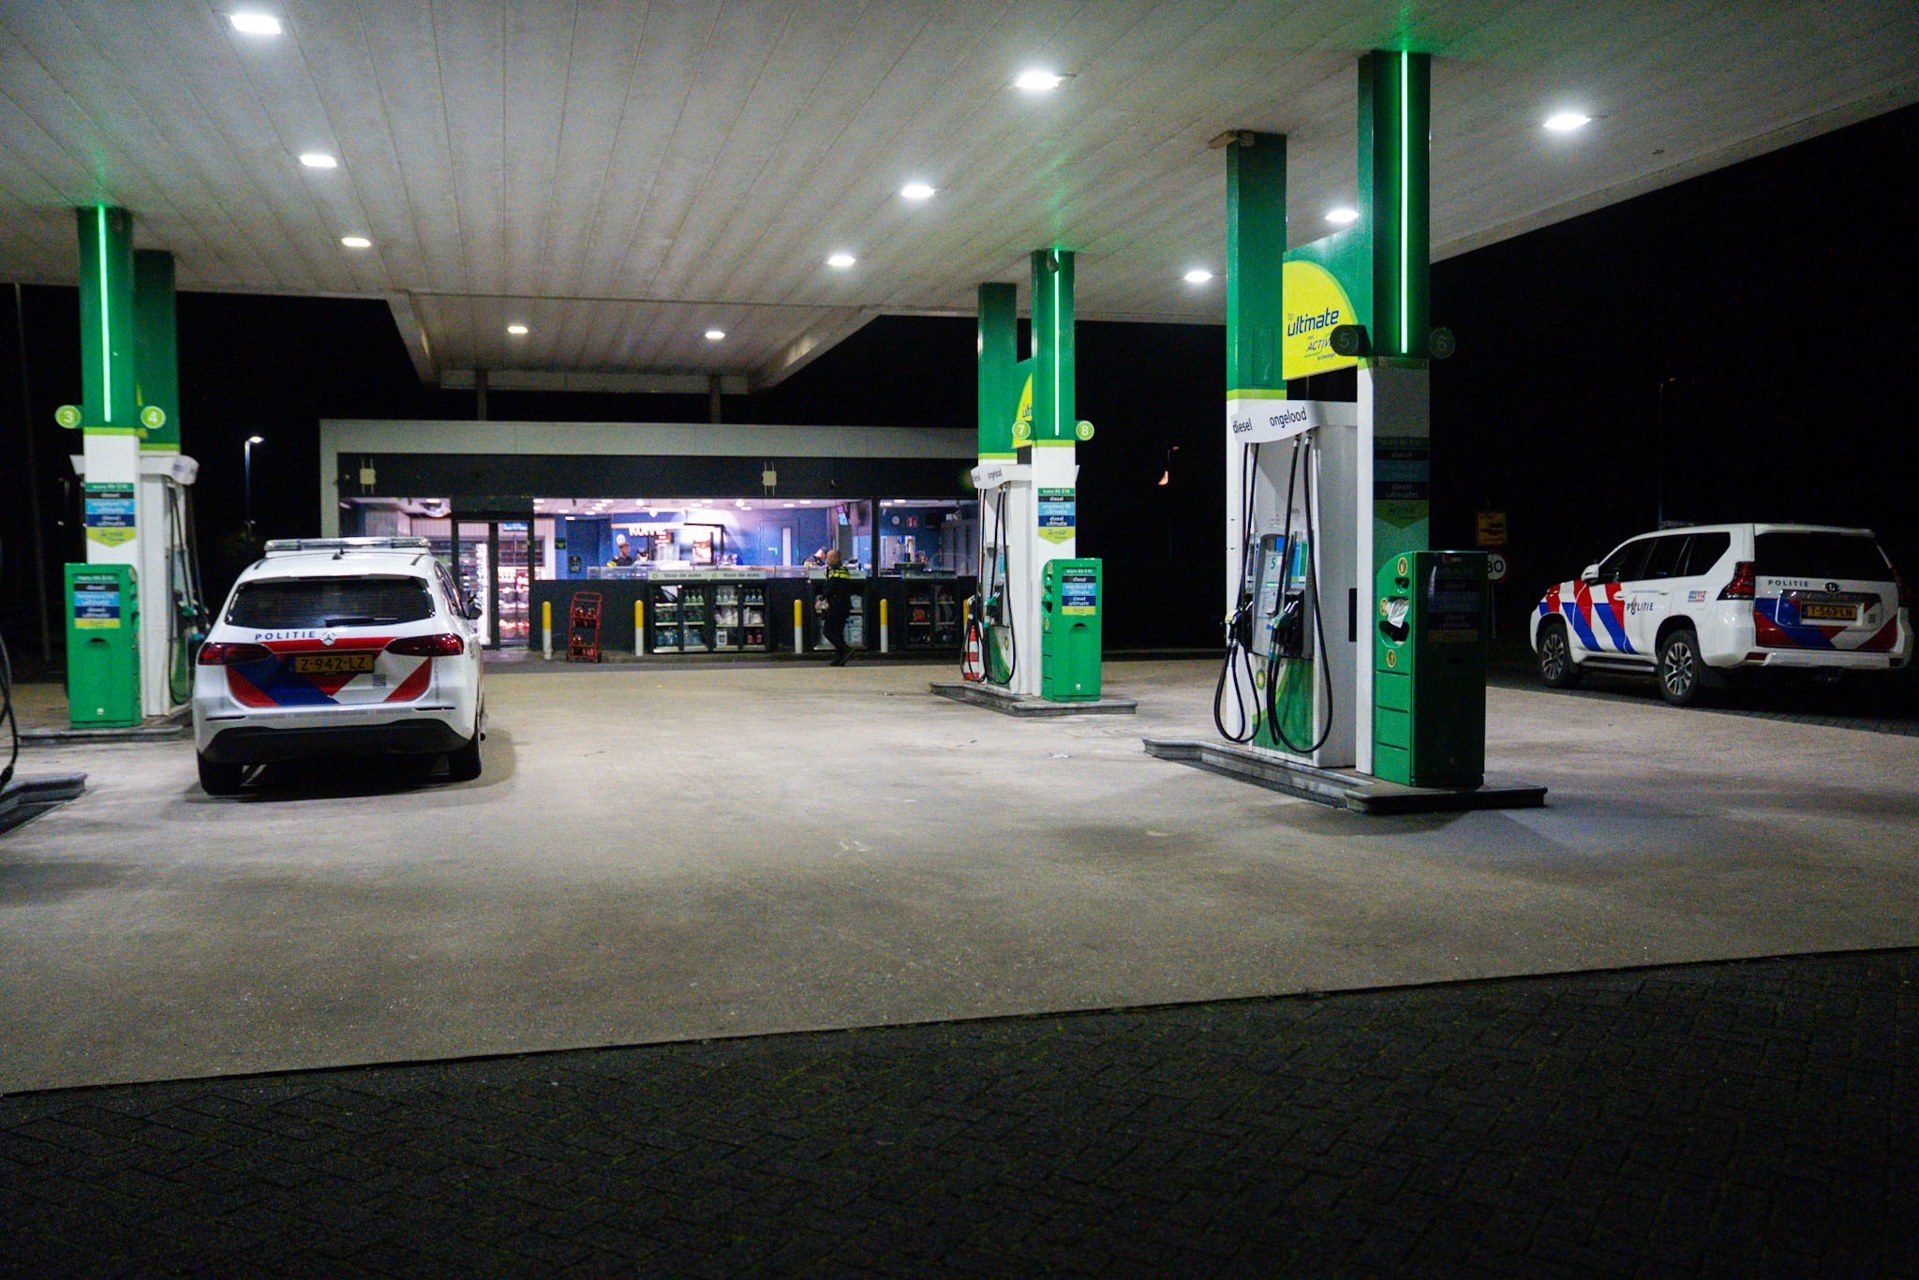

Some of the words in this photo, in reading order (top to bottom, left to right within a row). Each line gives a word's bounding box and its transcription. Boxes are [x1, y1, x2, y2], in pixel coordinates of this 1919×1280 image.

[1287, 307, 1340, 337] ultimate
[64, 410, 75, 423] 3
[147, 411, 159, 423] 4
[1269, 406, 1307, 429] ongelood
[1017, 424, 1025, 436] 7
[1081, 424, 1089, 436] 8
[1232, 415, 1253, 434] diesel
[1270, 557, 1276, 570] 5
[1768, 579, 1809, 587] POLITIE
[254, 630, 316, 641] POLITIE
[301, 656, 367, 671] Z-942-LZ
